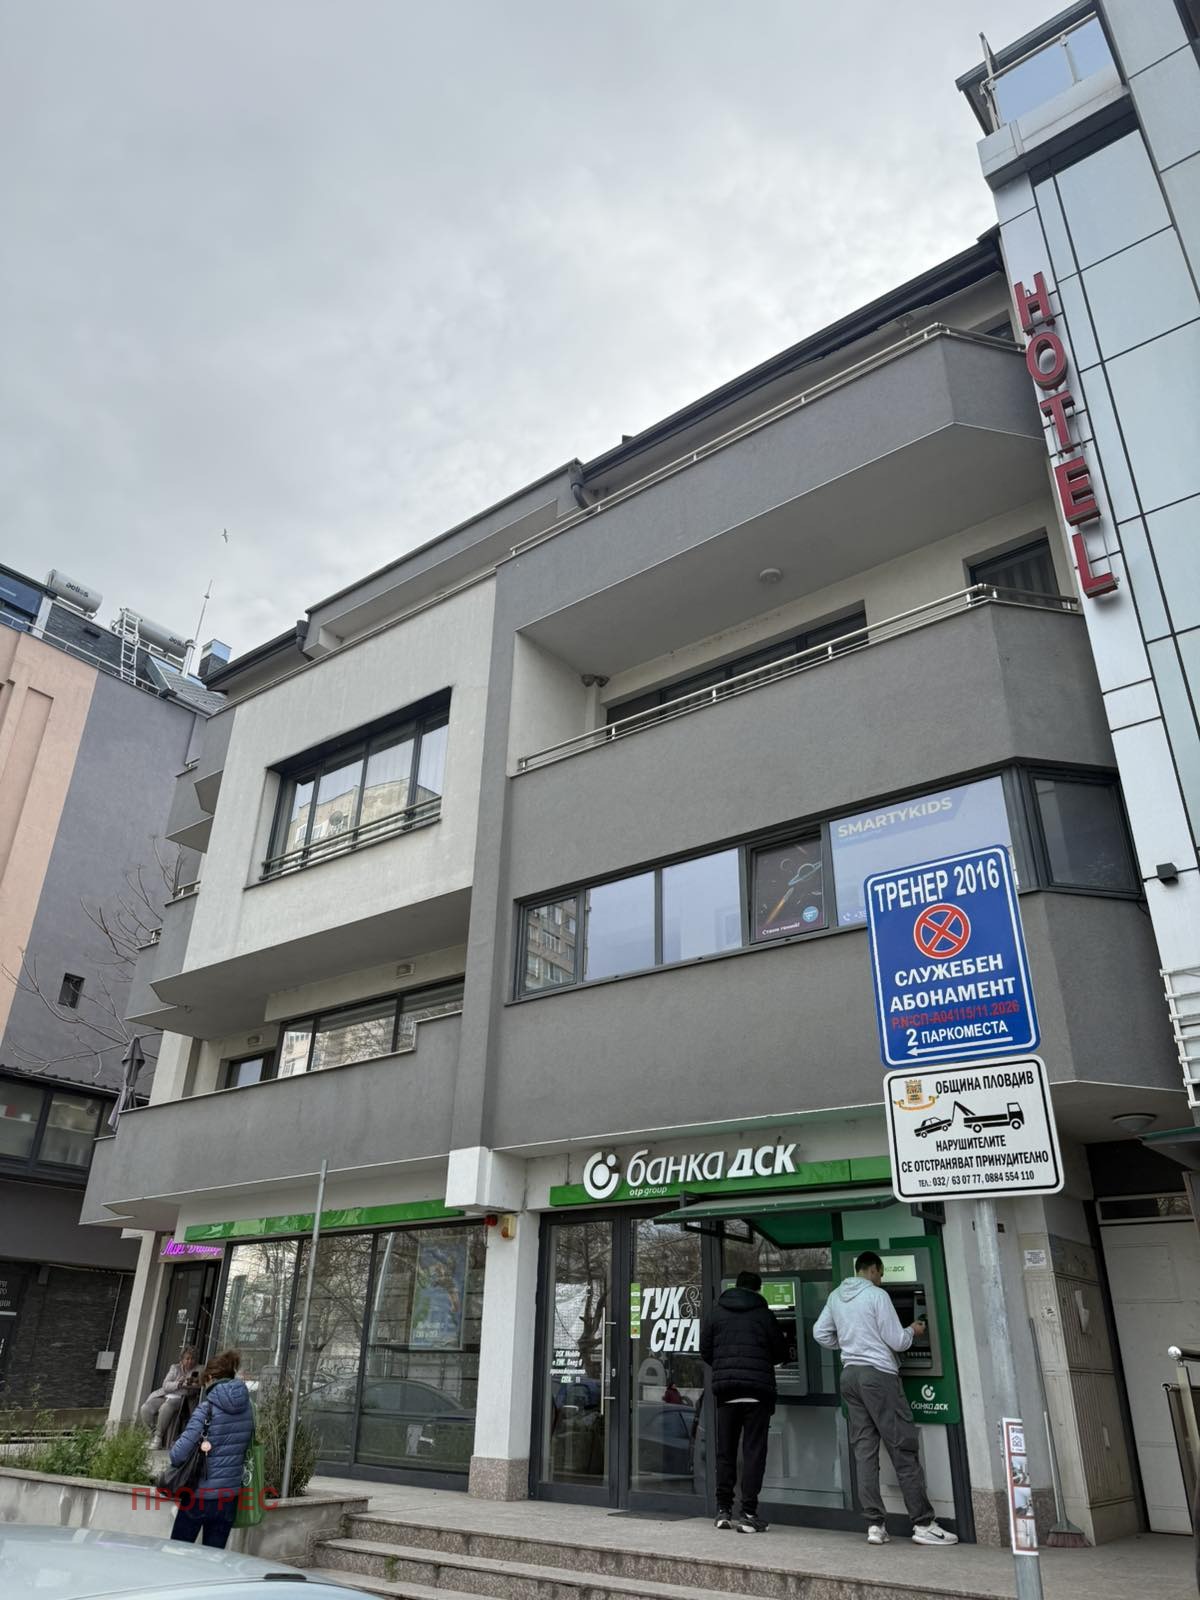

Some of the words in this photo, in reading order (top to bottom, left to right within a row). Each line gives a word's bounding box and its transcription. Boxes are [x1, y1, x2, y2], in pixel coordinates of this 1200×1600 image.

[1014, 271, 1119, 598] HOTEL
[837, 797, 953, 839] SMARTYKIDS
[874, 869, 948, 913] ТРЕНЕР
[954, 857, 1001, 897] 2016
[894, 953, 1004, 988] СЛУЖЕБЕН
[890, 976, 1017, 1013] АБОНАМЕНТ
[906, 1028, 919, 1047] 2
[921, 1019, 1009, 1044] ПАРКОМЕСТА
[935, 1074, 982, 1096] ОБЩИНА
[983, 1066, 1035, 1091] ПЛОВДИВ
[936, 1134, 1007, 1152] НАРУШИТЕЛИТЕ
[626, 1149, 724, 1188] банка
[727, 1143, 798, 1179] ДСК
[902, 1160, 913, 1173] СЕ
[914, 1155, 974, 1172] ОТСТРАНЯВАТ
[976, 1150, 1049, 1169] ПРИНУДИТЕЛНО
[952, 1175, 961, 1185] 63
[962, 1174, 971, 1185] 07
[985, 1172, 1004, 1183] 0884
[1005, 1171, 1020, 1182] 554
[1021, 1170, 1035, 1181] 110
[629, 1187, 643, 1196] otp
[644, 1185, 668, 1196] group
[640, 1286, 686, 1319] ТУК
[650, 1318, 701, 1353] СЕГА
